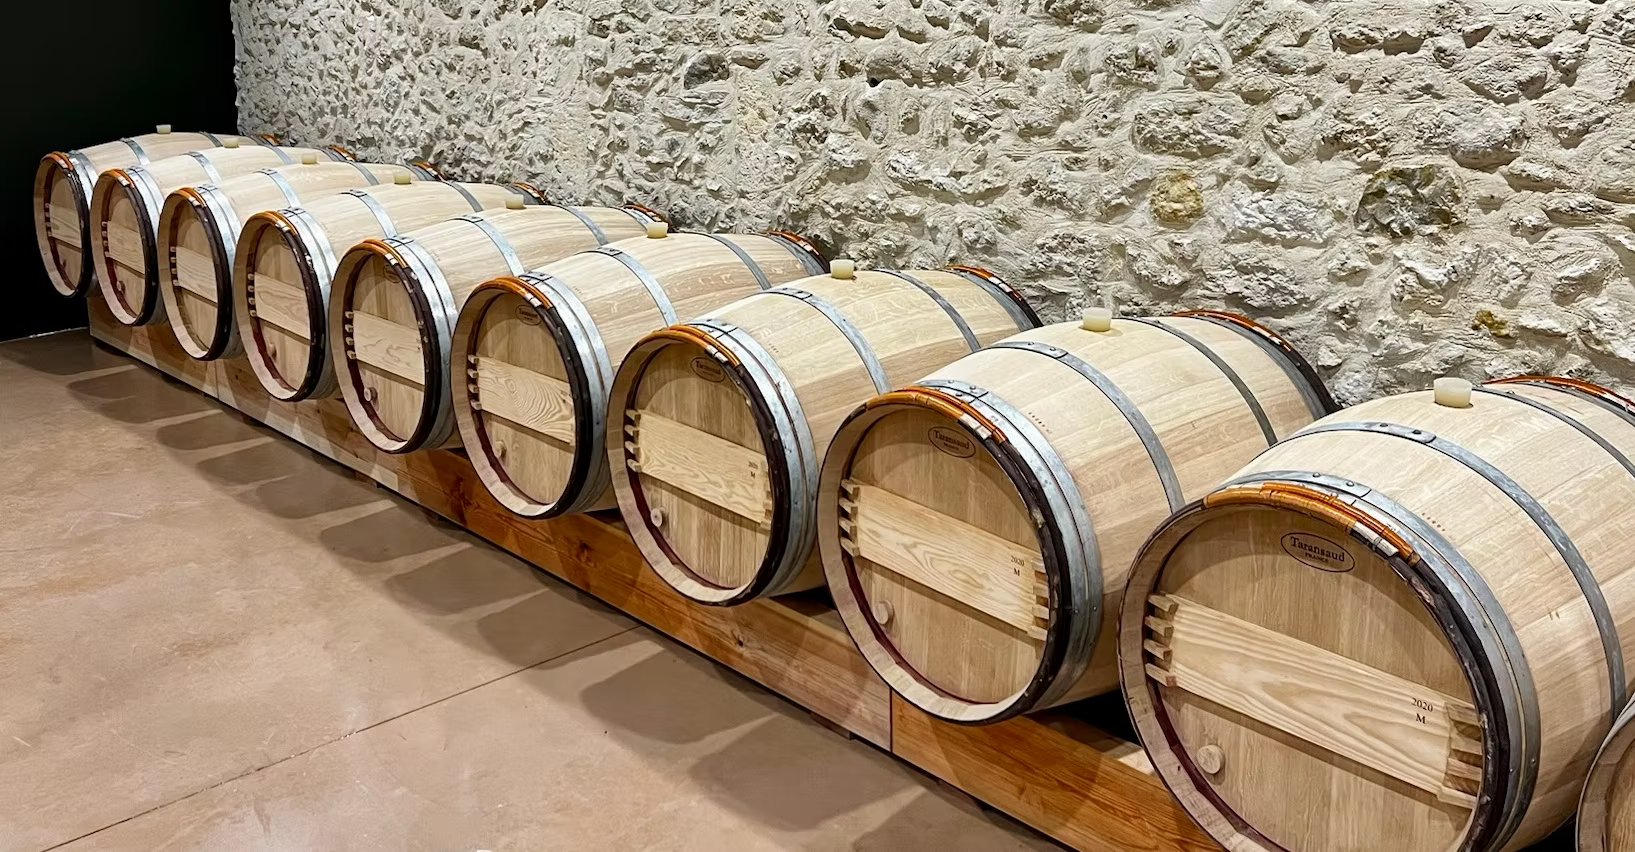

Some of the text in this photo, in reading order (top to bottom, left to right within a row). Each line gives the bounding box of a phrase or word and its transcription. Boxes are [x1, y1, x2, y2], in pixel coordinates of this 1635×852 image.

[1290, 536, 1345, 562] Taransaud
[1013, 567, 1021, 577] M
[1411, 697, 1433, 712] 2020
[1415, 713, 1426, 724] M
